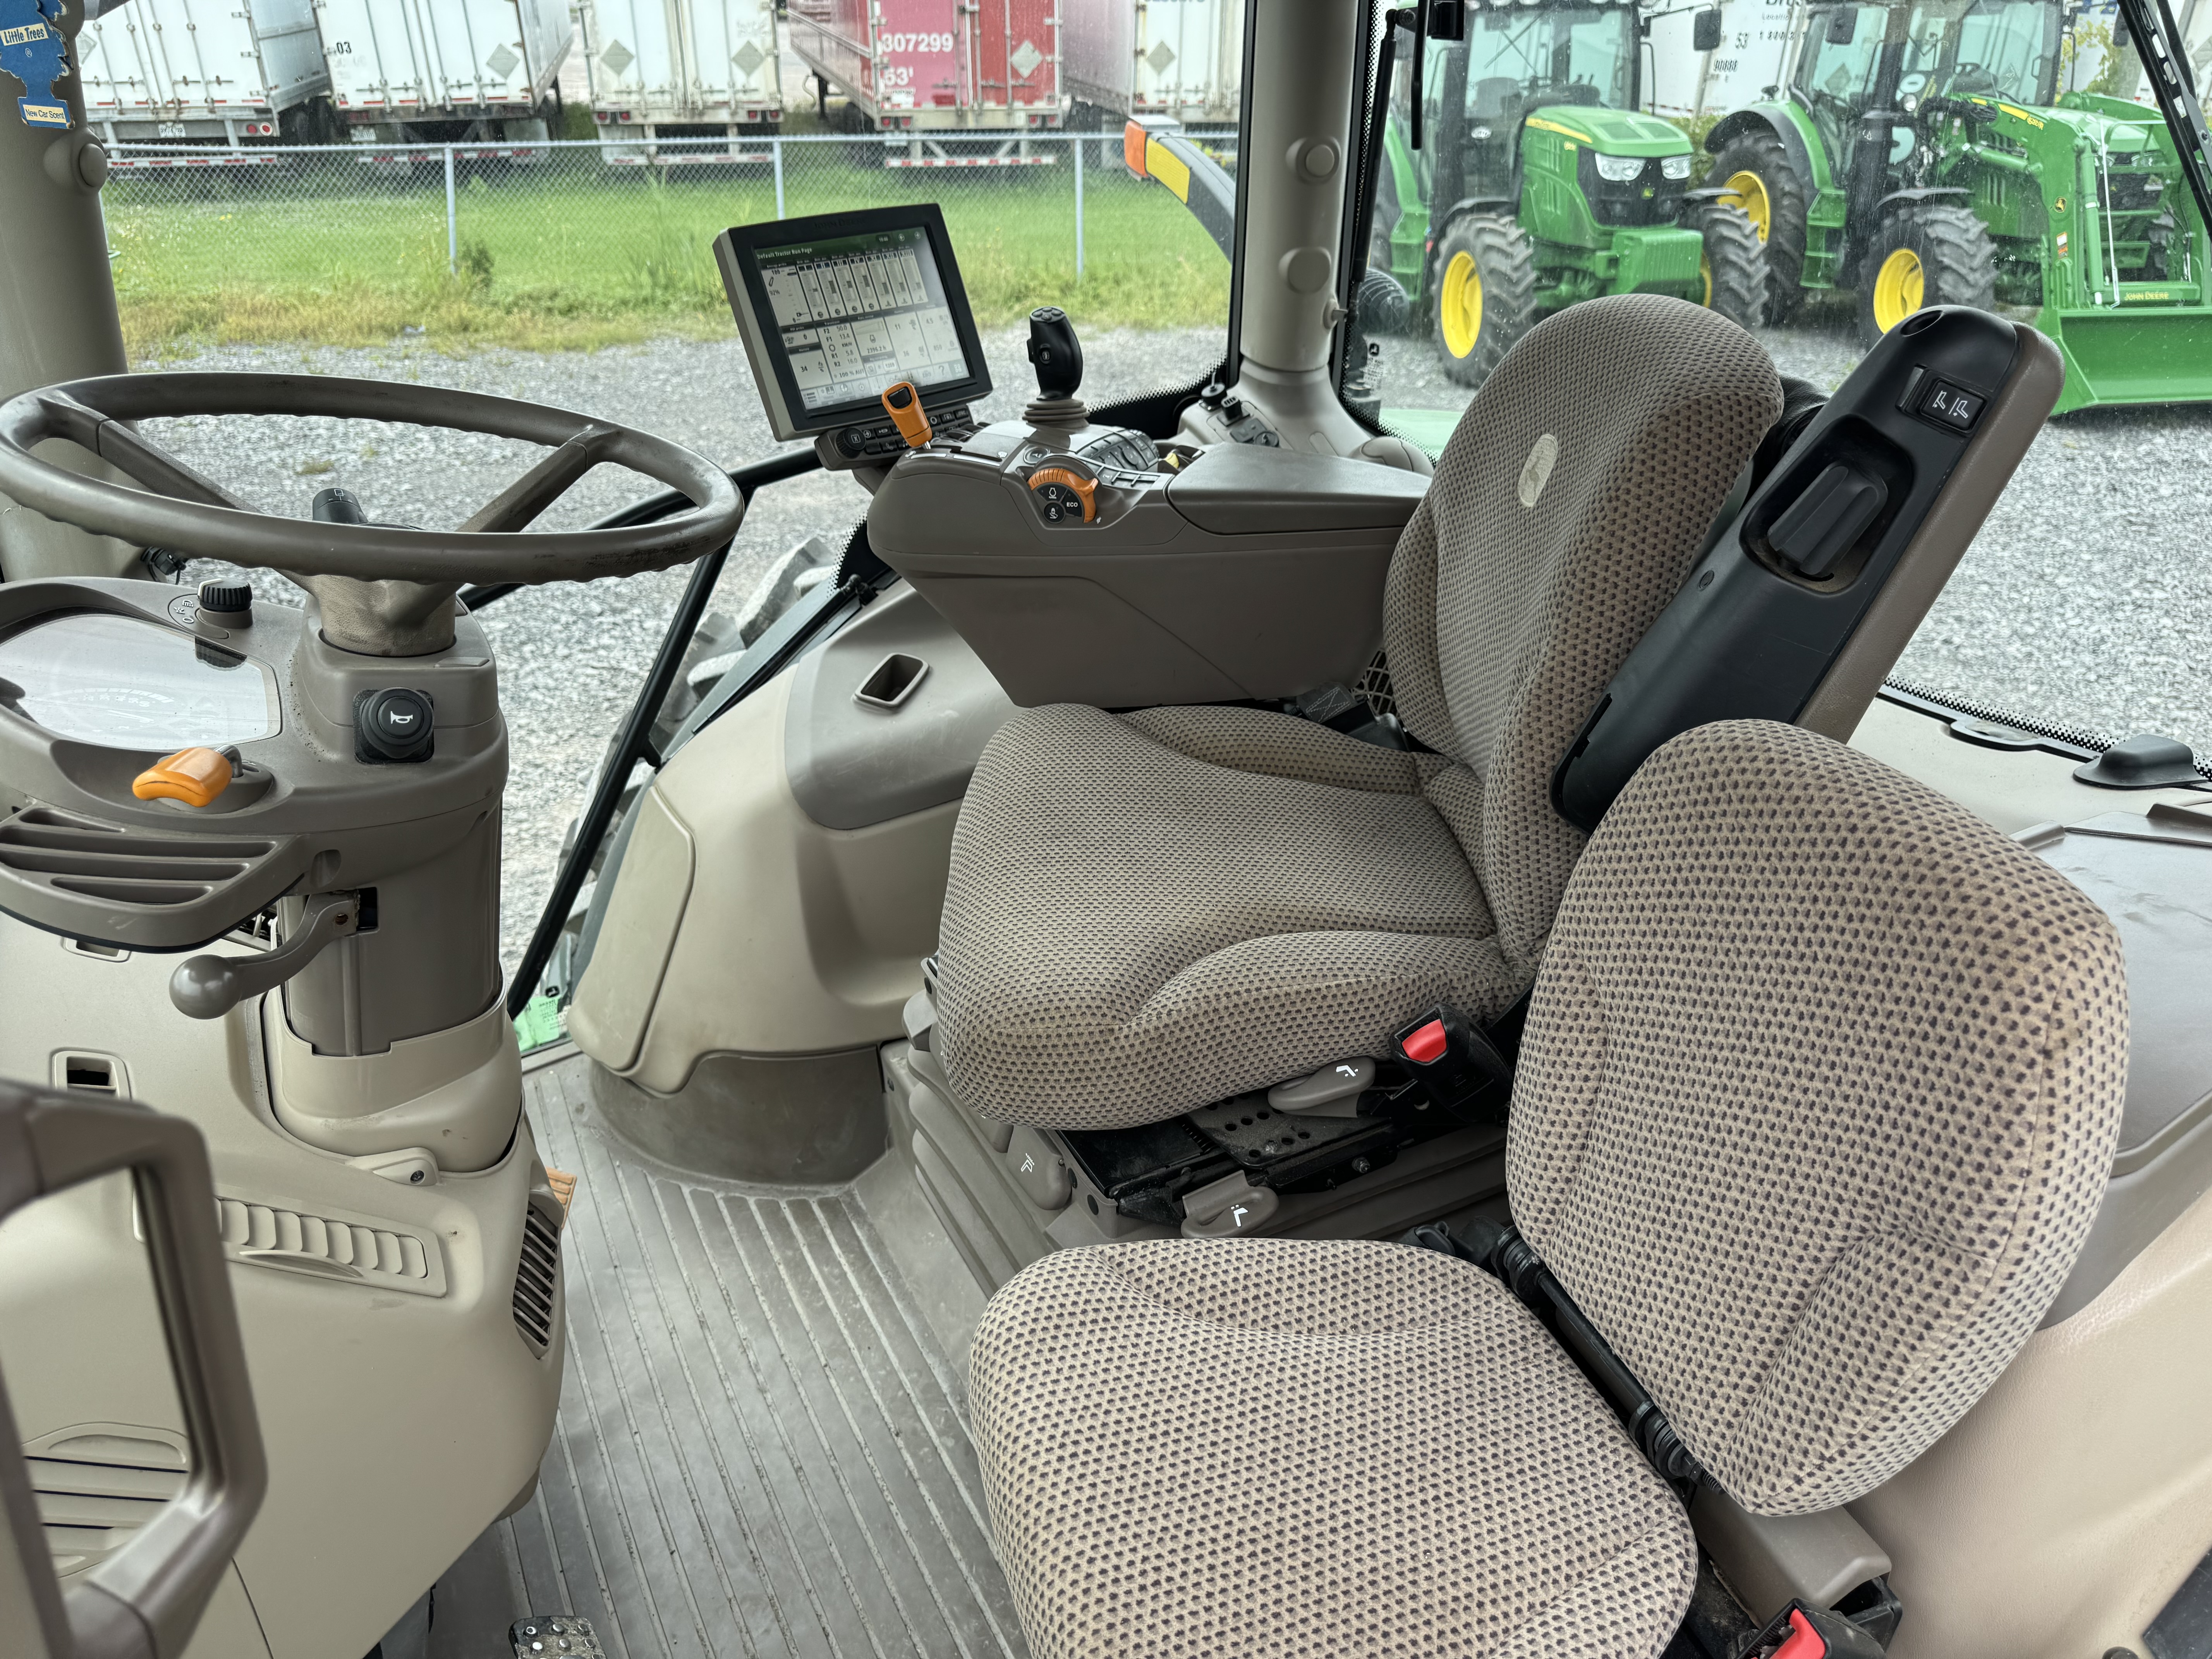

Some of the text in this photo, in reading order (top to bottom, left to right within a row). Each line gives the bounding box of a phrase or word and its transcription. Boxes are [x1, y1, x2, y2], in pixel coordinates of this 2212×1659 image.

[4, 27, 45, 44] Little Trees
[882, 33, 954, 53] 307299
[1735, 32, 1749, 49] 53
[336, 41, 352, 54] 03
[49, 111, 65, 119] Scent
[2124, 291, 2169, 301] JOHN DEERE
